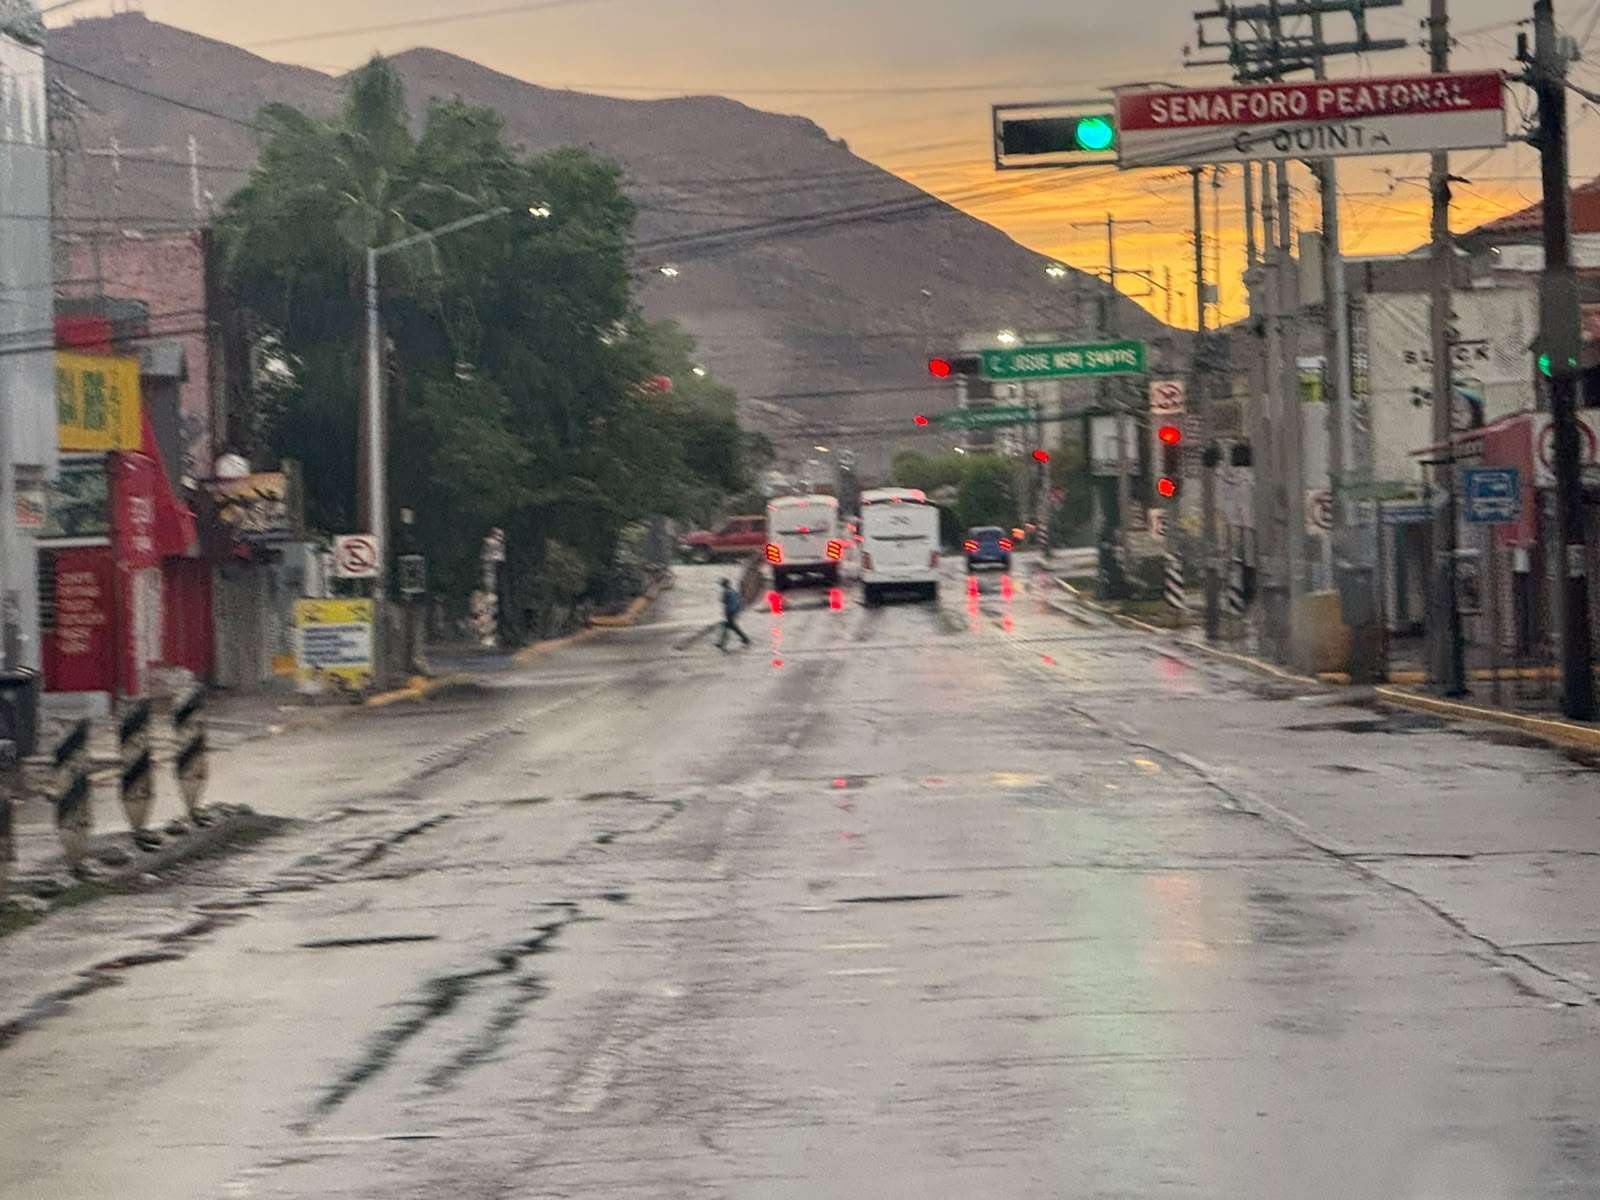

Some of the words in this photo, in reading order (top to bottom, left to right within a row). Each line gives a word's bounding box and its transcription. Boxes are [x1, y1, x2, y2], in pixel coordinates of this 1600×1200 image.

[1150, 90, 1308, 123] SEMAFORO
[1316, 80, 1471, 113] PEATONAL
[1272, 123, 1391, 152] QUINTA
